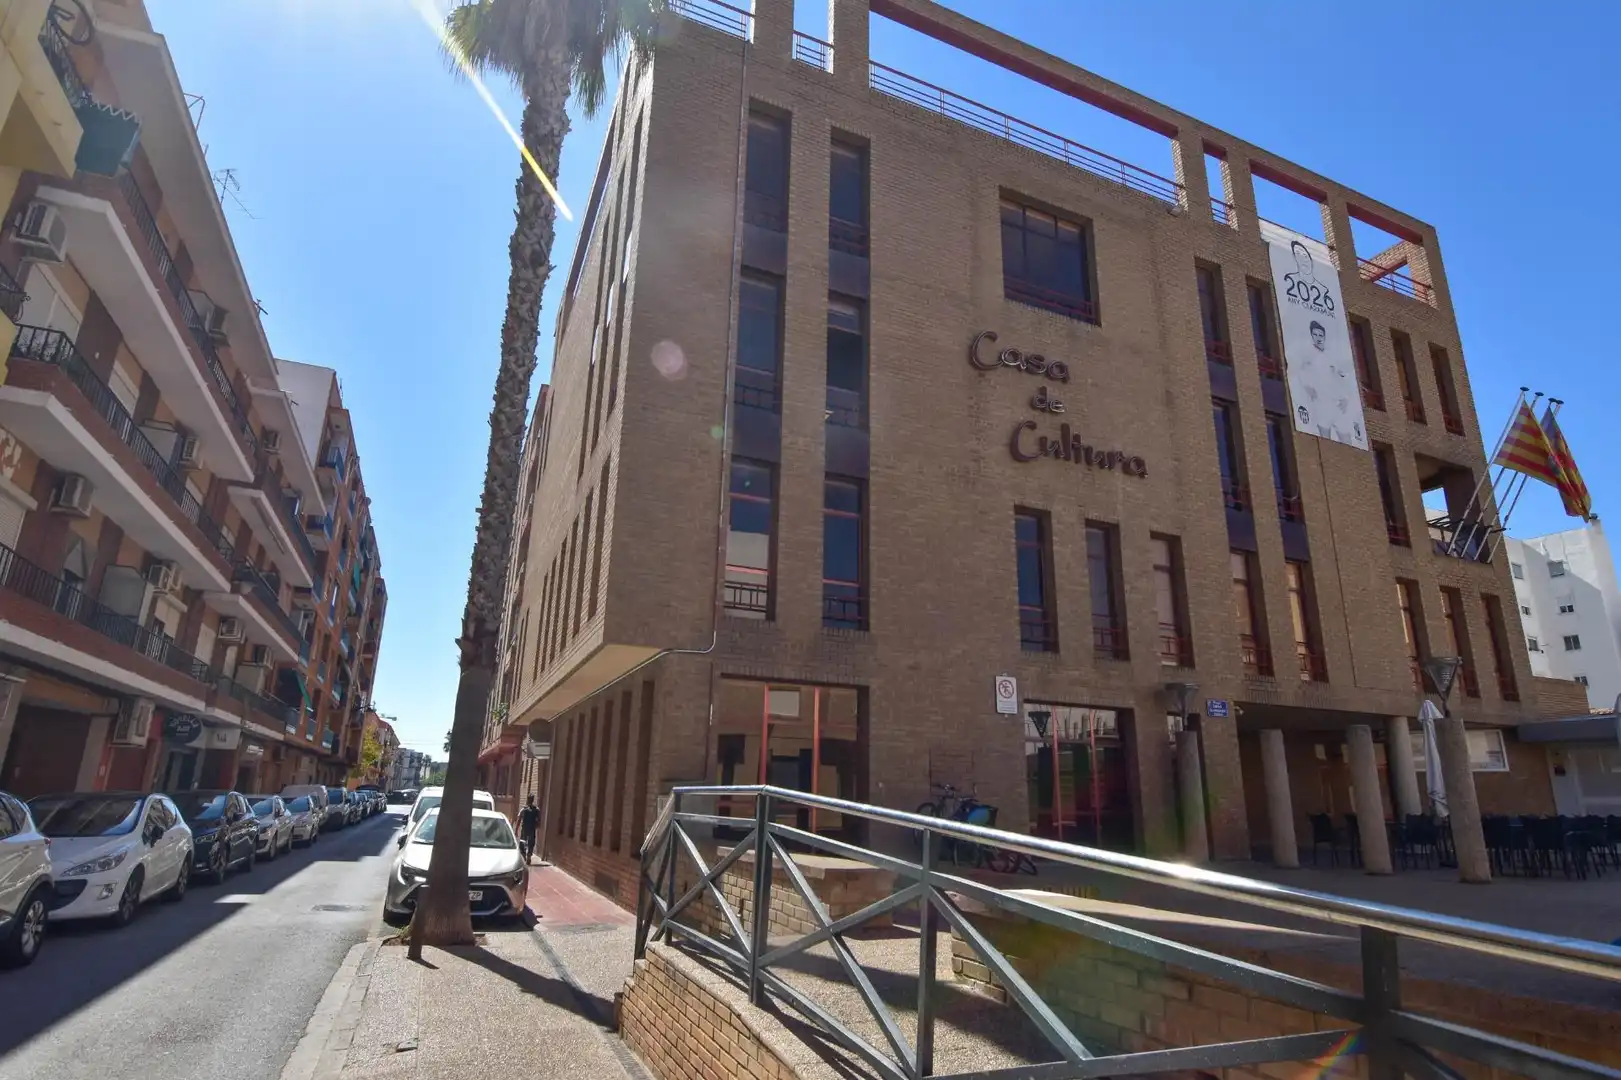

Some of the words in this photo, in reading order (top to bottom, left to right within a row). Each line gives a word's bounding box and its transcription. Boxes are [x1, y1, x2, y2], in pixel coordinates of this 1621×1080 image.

[1284, 271, 1334, 311] 2026
[969, 330, 1070, 384] Casa
[1031, 385, 1066, 413] de
[1009, 420, 1149, 479] Cultura
